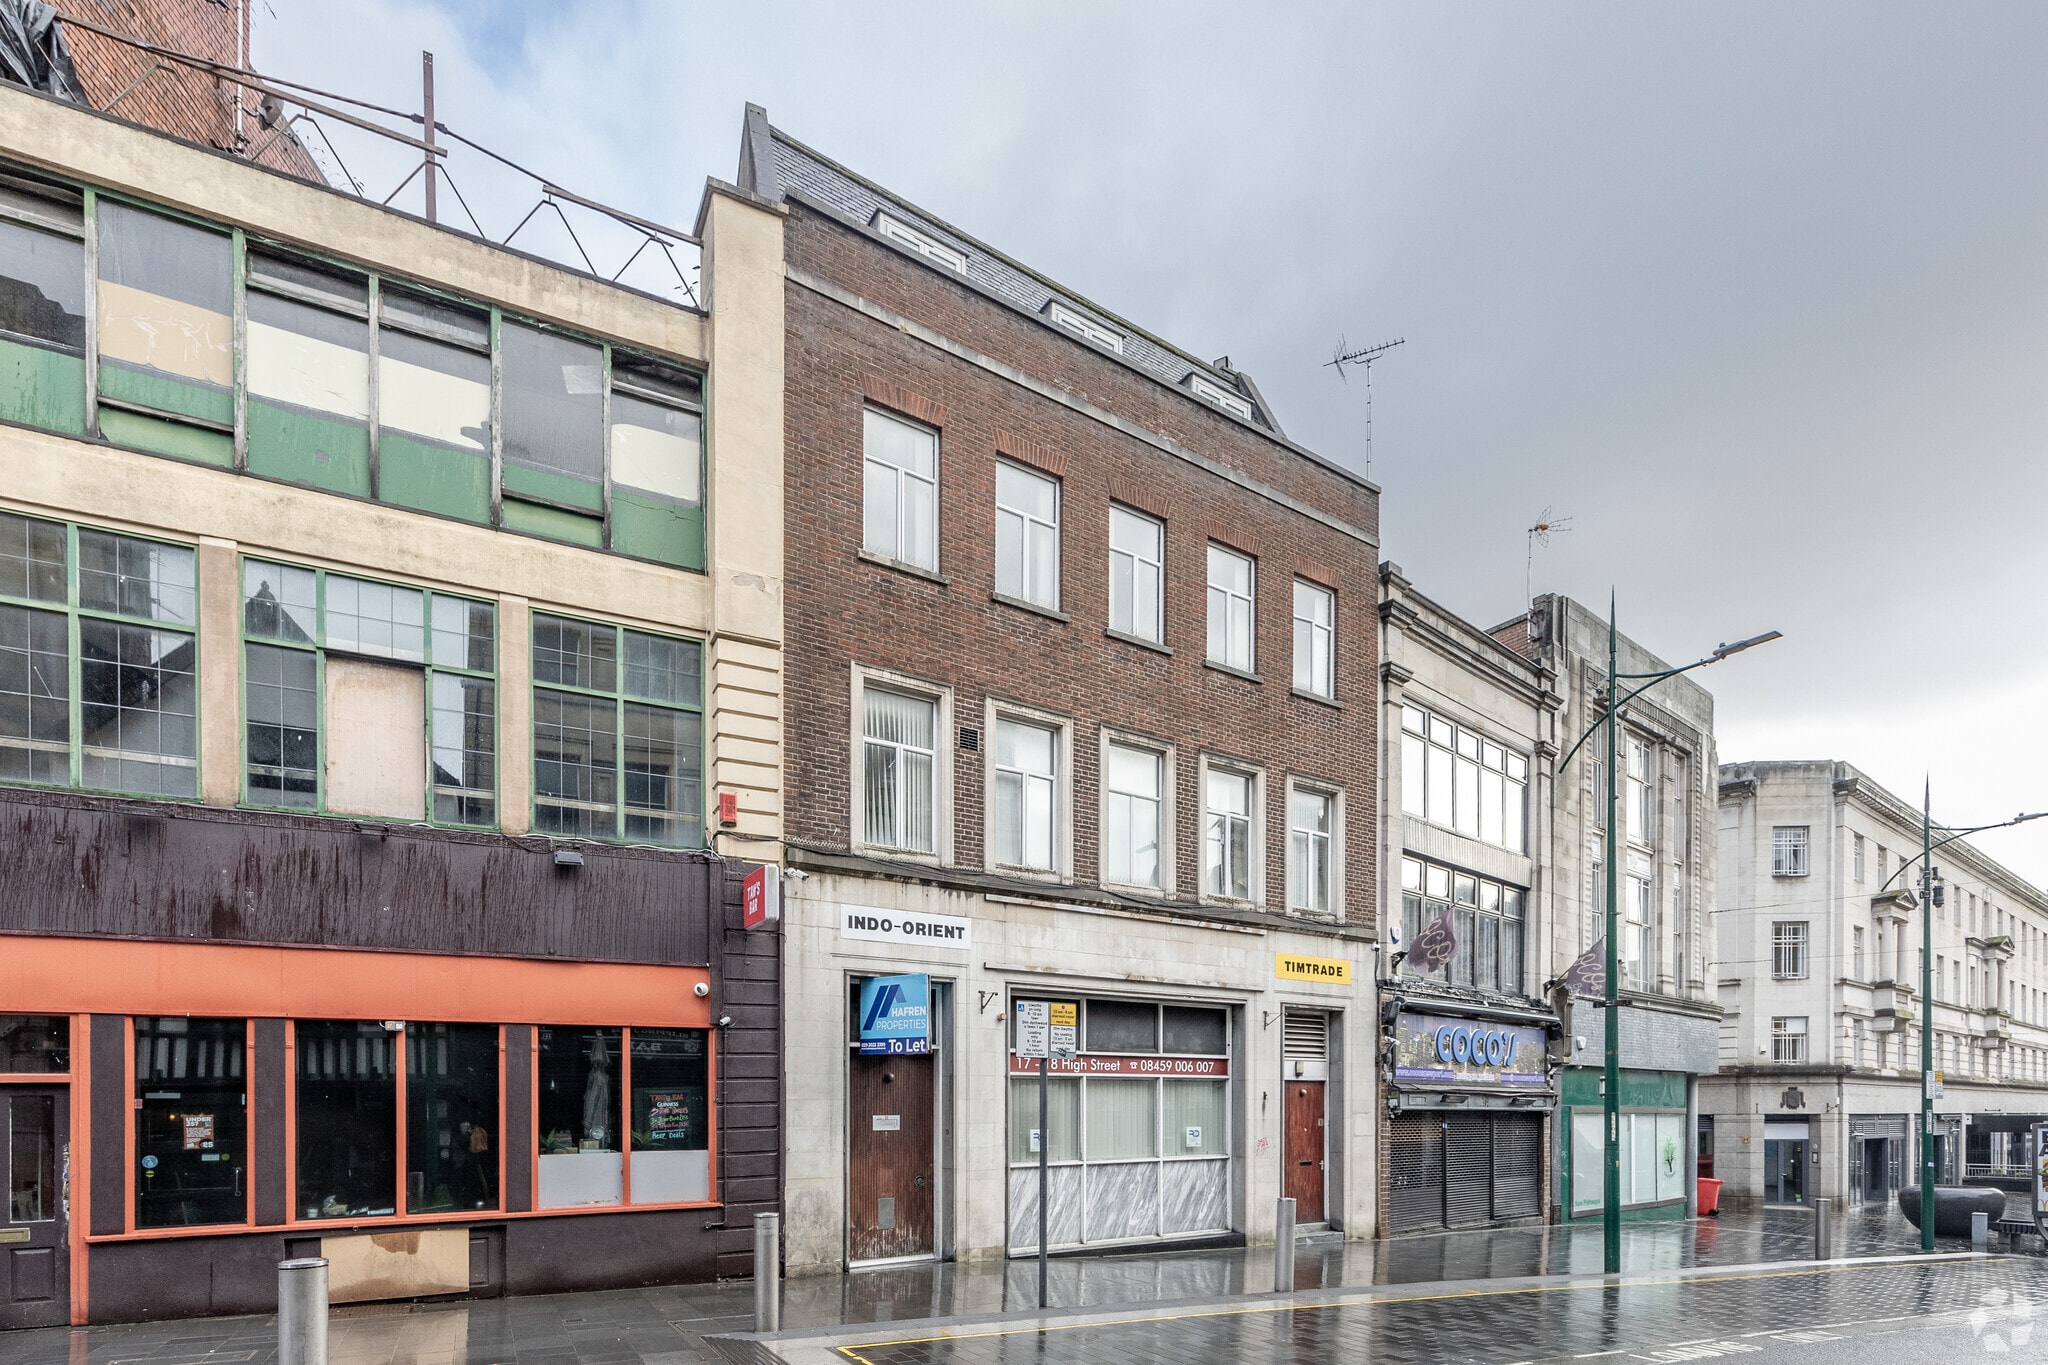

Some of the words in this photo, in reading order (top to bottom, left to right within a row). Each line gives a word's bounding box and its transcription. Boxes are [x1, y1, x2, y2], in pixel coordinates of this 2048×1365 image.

[747, 881, 761, 901] TAW'S
[749, 898, 758, 915] BAR
[848, 915, 965, 939] INDO-ORIENT
[1285, 961, 1343, 977] TIMTRADE
[891, 1006, 926, 1017] HAFREN
[876, 1019, 926, 1030] PROPERTIES
[888, 1039, 903, 1053] To
[906, 1038, 925, 1052] Let
[1017, 1058, 1031, 1069] 17
[1062, 1058, 1086, 1072] High
[1090, 1058, 1120, 1071] Street
[1140, 1060, 1172, 1072] 08459
[1175, 1060, 1194, 1072] 006
[1196, 1062, 1214, 1073] 007
